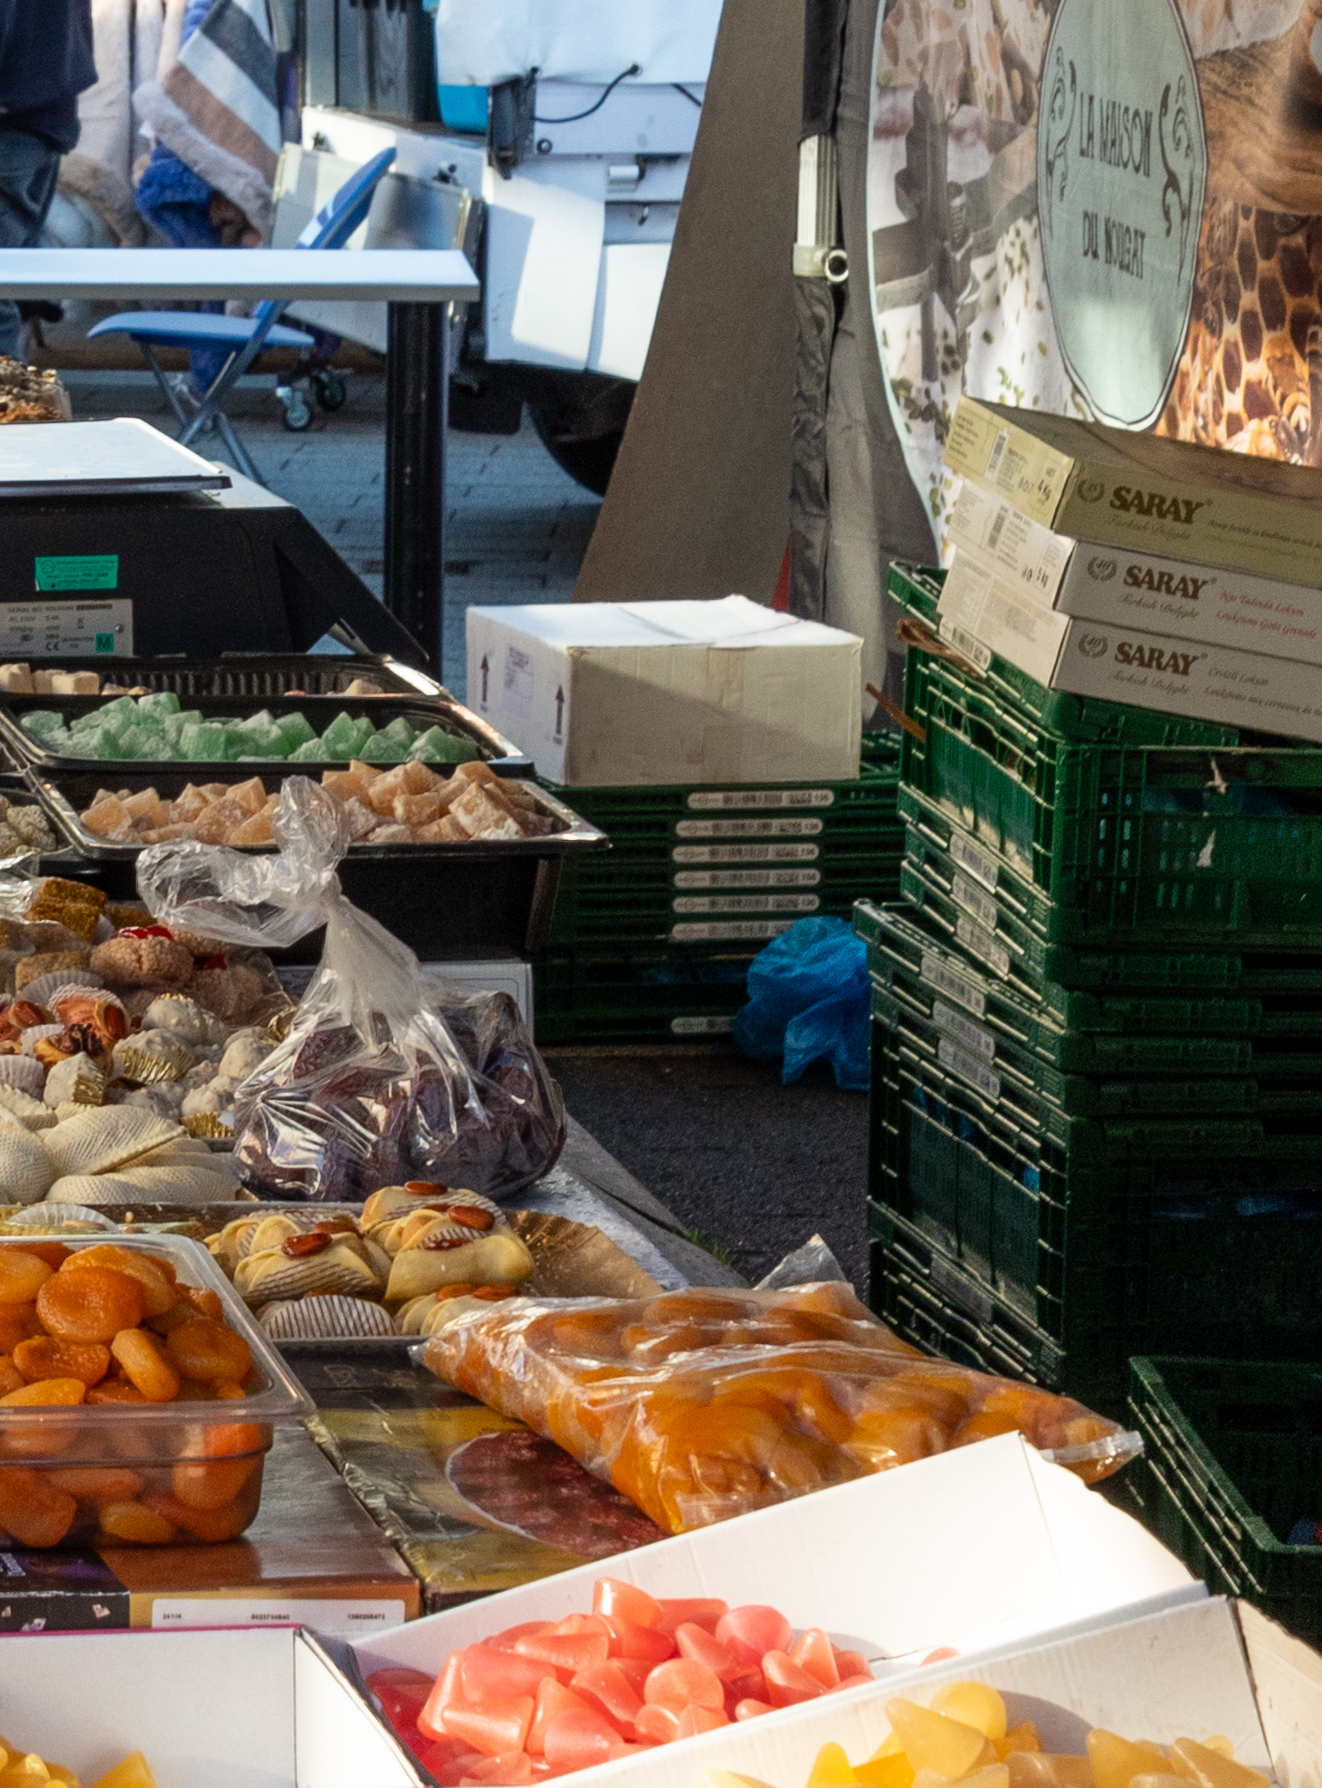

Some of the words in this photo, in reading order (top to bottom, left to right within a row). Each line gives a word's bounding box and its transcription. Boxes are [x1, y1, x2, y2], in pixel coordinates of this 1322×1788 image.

[1079, 92, 1095, 159] LA
[1099, 97, 1153, 178] MAISON
[1082, 210, 1100, 260] DU
[1104, 216, 1146, 280] NOUGAT
[1110, 485, 1205, 525] SARAY
[1123, 564, 1208, 600] SARAY
[1114, 642, 1199, 676] SARAY
